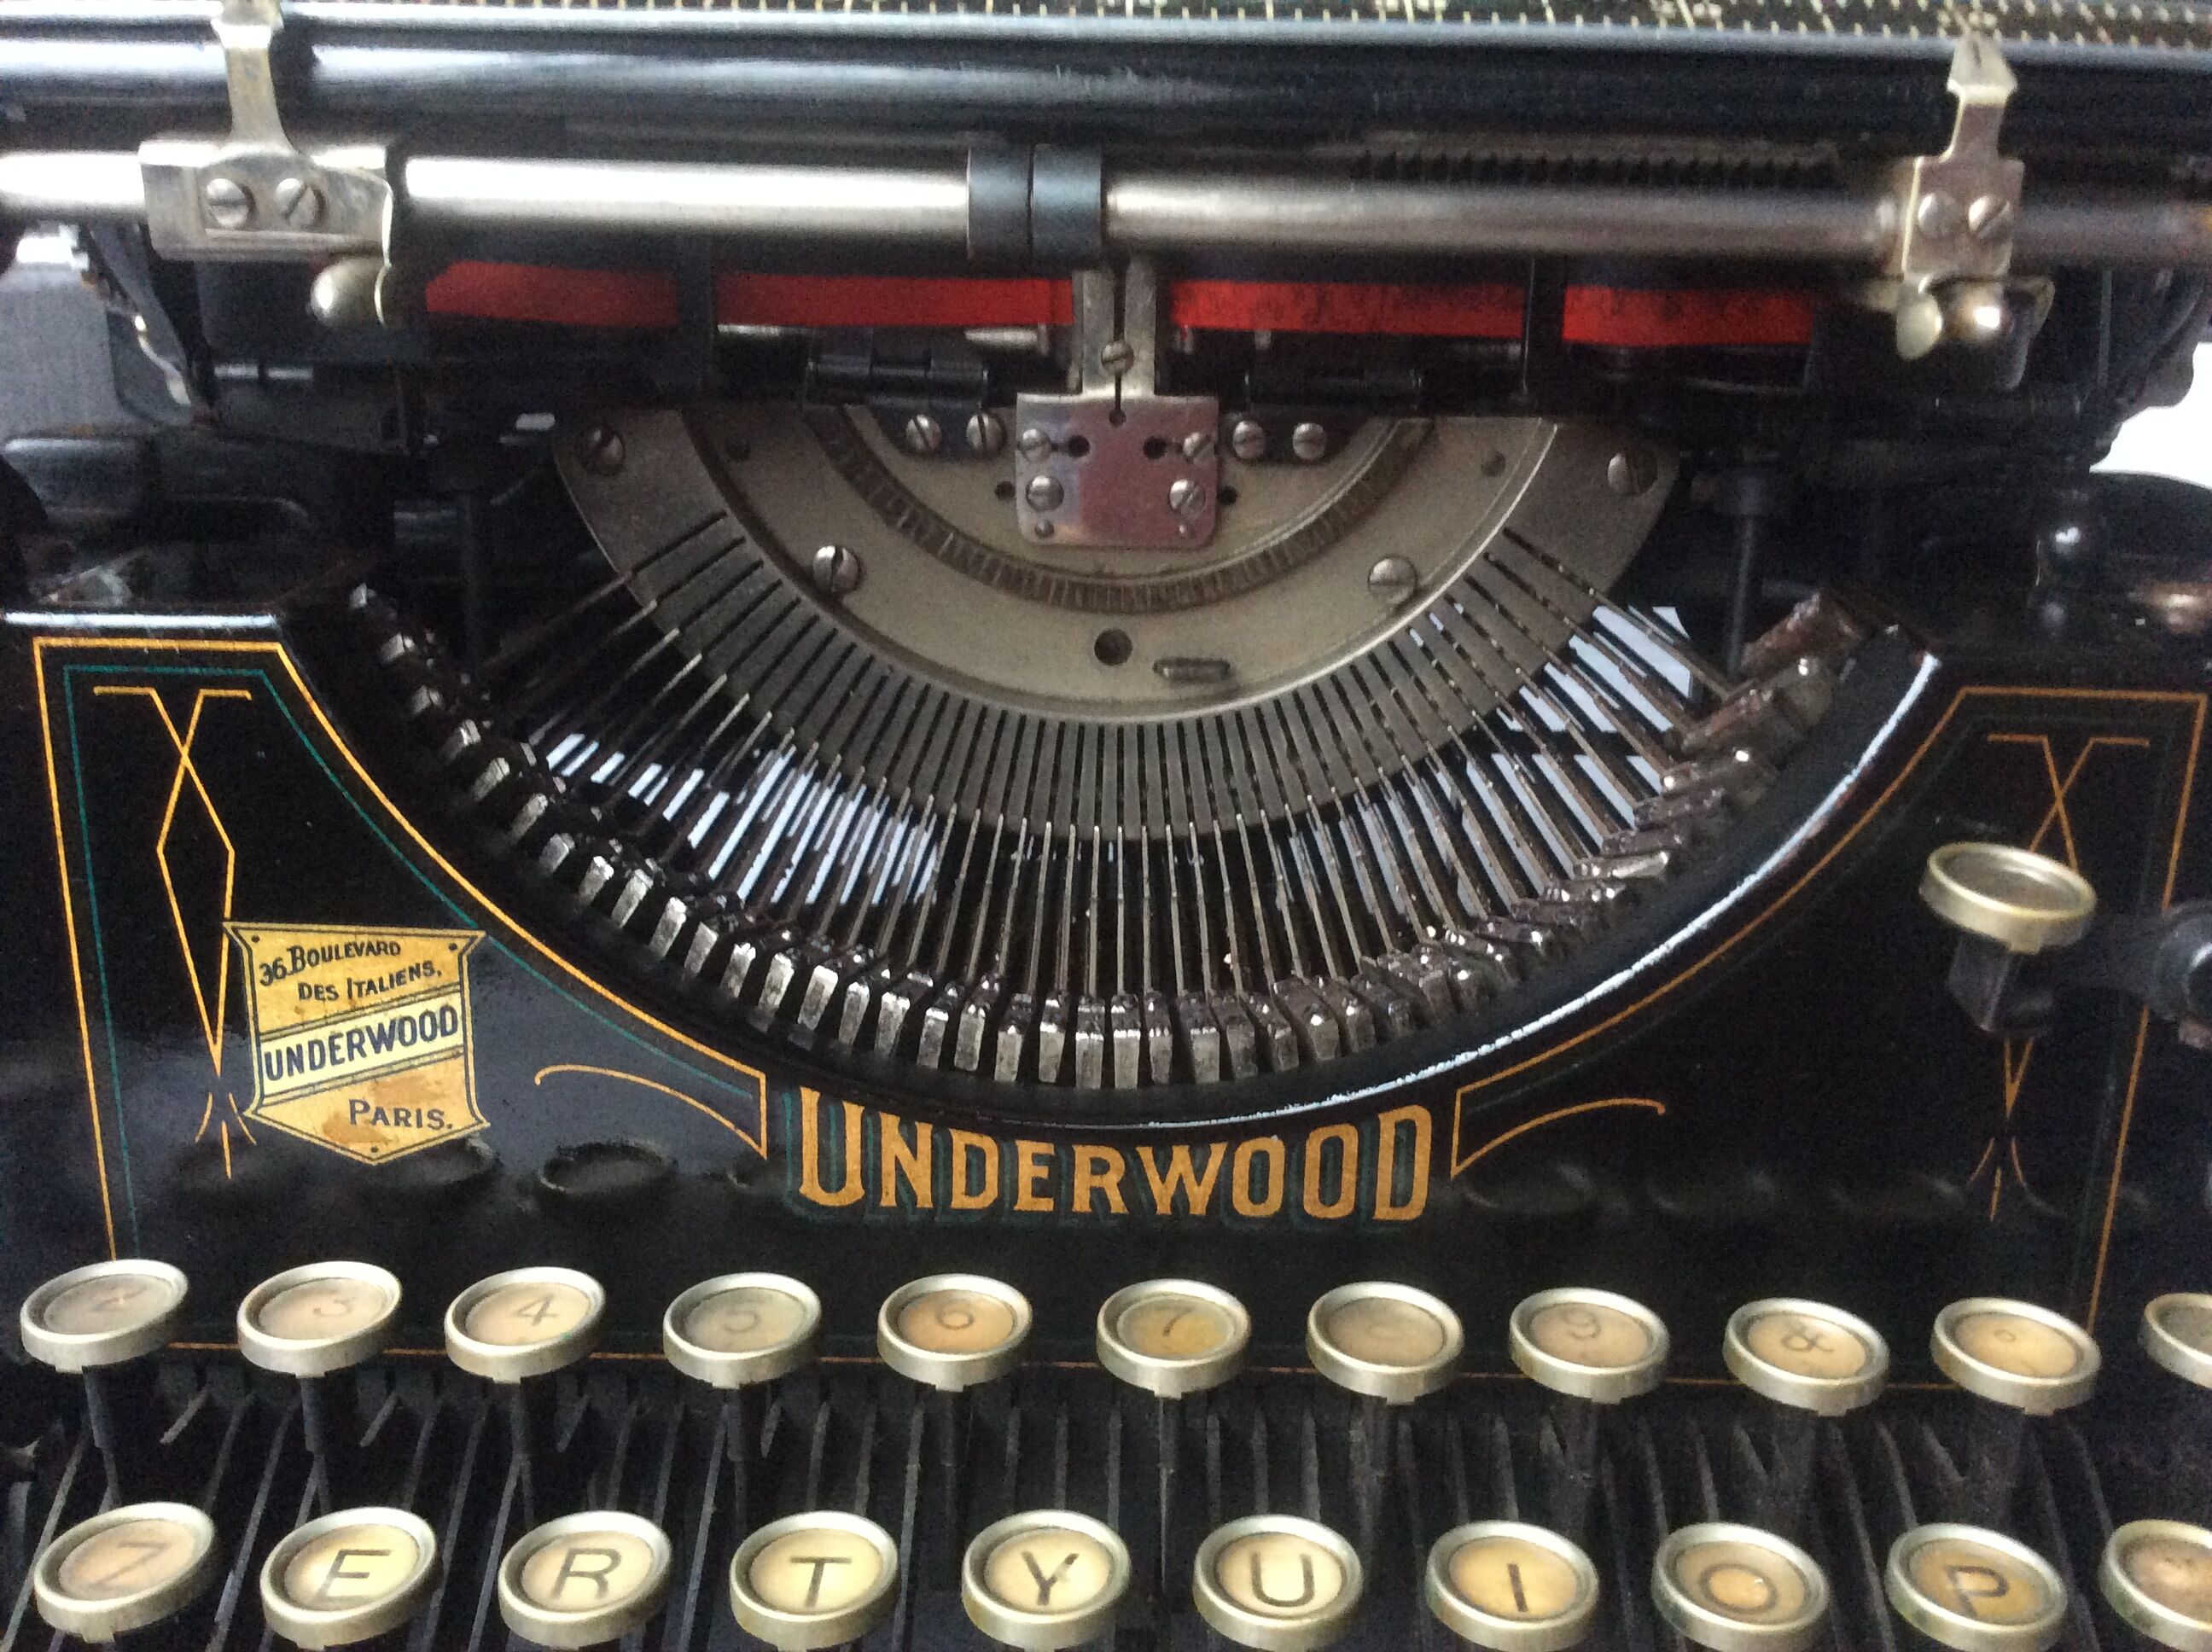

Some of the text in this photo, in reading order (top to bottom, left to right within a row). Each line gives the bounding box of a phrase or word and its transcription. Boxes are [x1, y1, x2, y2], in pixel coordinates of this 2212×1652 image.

[298, 982, 340, 1001] DES
[264, 1004, 459, 1081] UNDERWOOD
[798, 1086, 1434, 1221] UNDERWOOD
[513, 1293, 557, 1327] 4
[316, 1548, 393, 1603] E
[550, 1546, 624, 1600] R
[789, 1556, 853, 1608] T
[1022, 1551, 1080, 1606] Y
[1250, 1550, 1315, 1608] U
[1505, 1562, 1528, 1613] I
[1698, 1563, 1778, 1614] O
[1945, 1563, 2008, 1620] P
